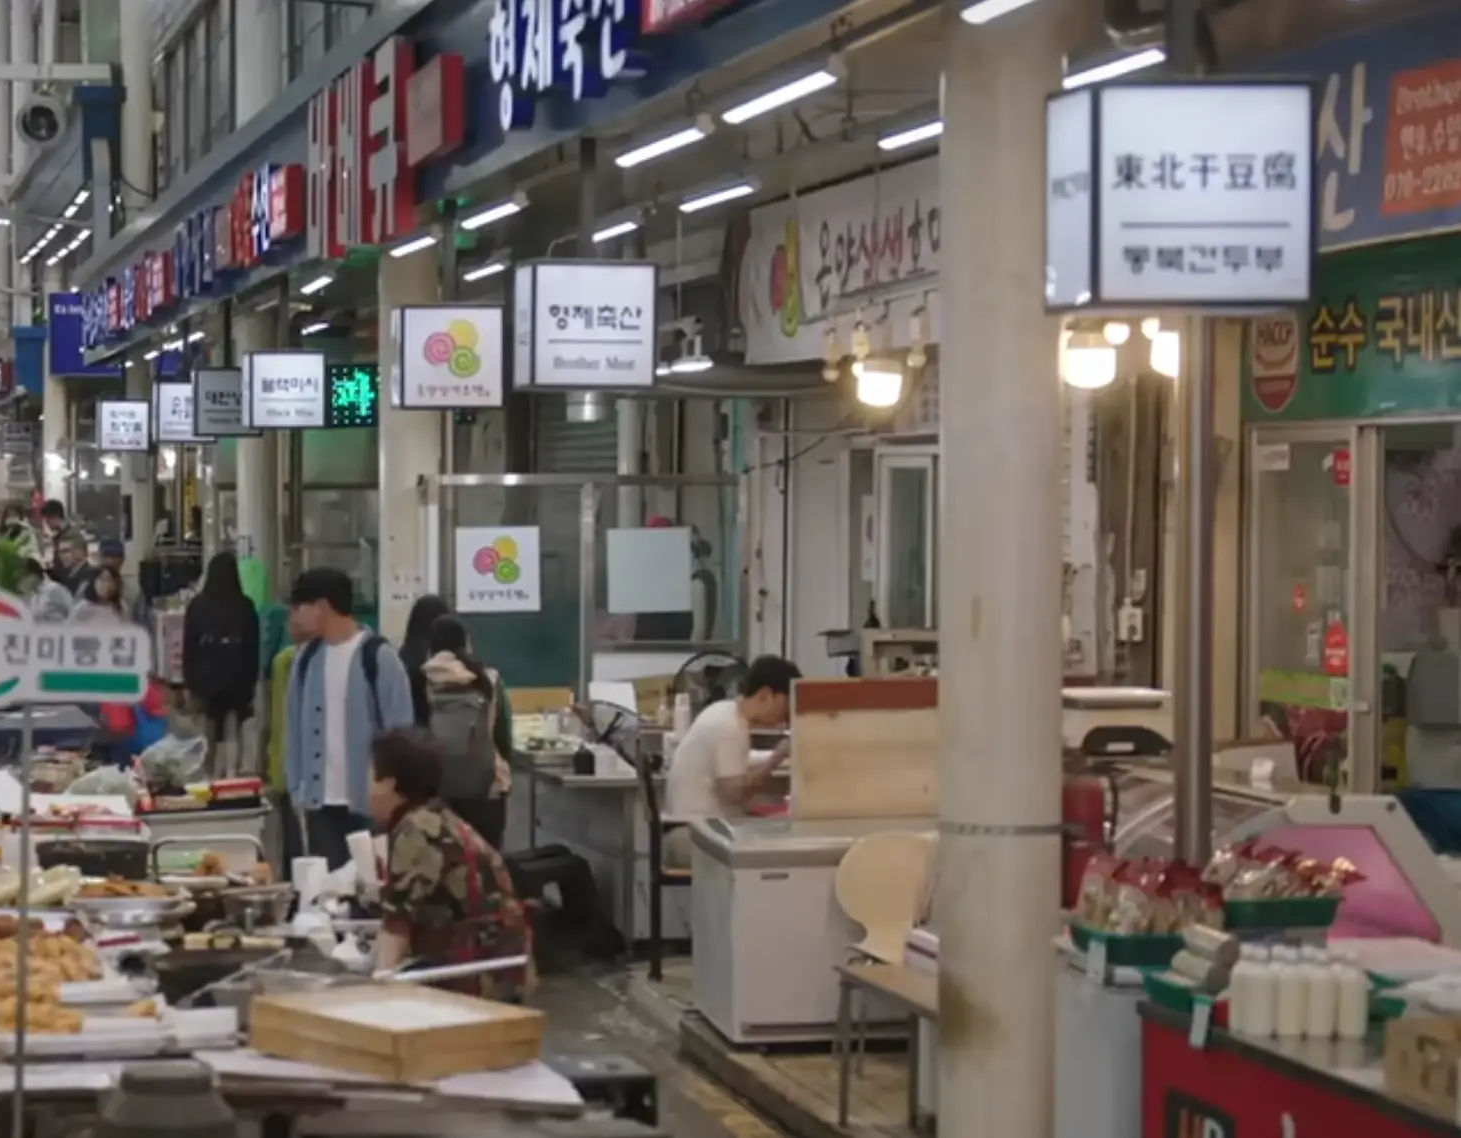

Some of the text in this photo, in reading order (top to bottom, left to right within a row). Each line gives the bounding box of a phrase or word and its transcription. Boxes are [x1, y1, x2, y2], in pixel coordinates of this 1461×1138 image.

[307, 34, 398, 259] 바베큐
[1112, 152, 1297, 190] 東北干豆腐
[548, 304, 643, 331] 형제축산
[1311, 304, 1366, 371] 순수
[3, 633, 138, 667] 진미빵집
